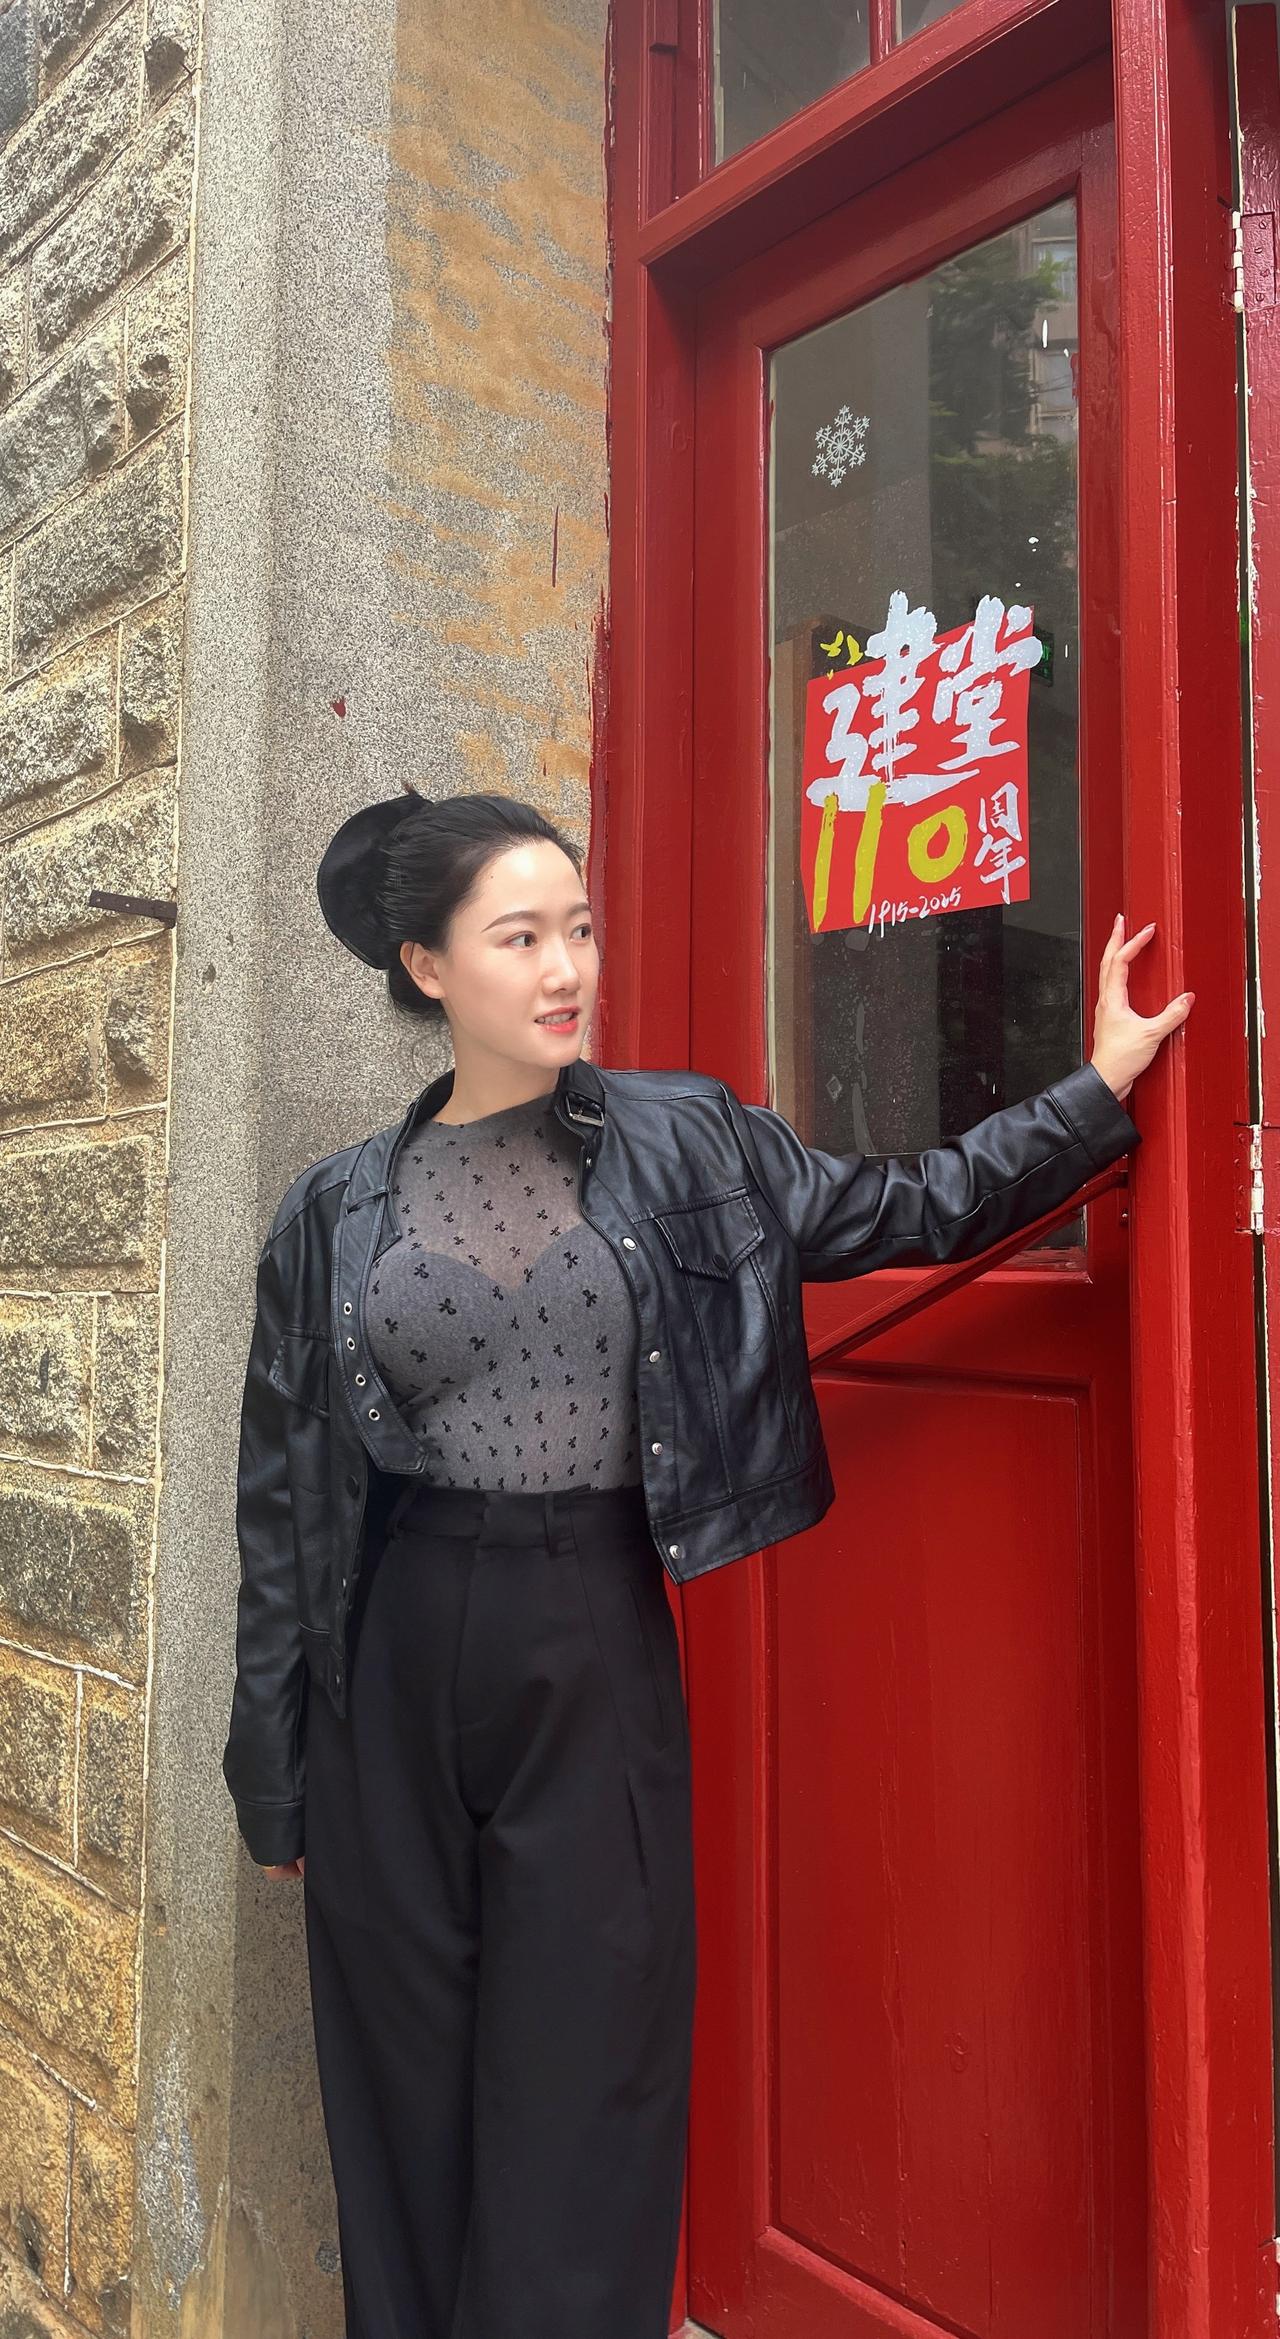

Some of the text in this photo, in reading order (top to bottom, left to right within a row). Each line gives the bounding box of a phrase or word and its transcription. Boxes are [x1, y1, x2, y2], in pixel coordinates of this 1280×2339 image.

[806, 589, 1043, 812] 建堂
[812, 780, 1026, 932] 110 周年
[868, 886, 962, 938] 1915-2025
